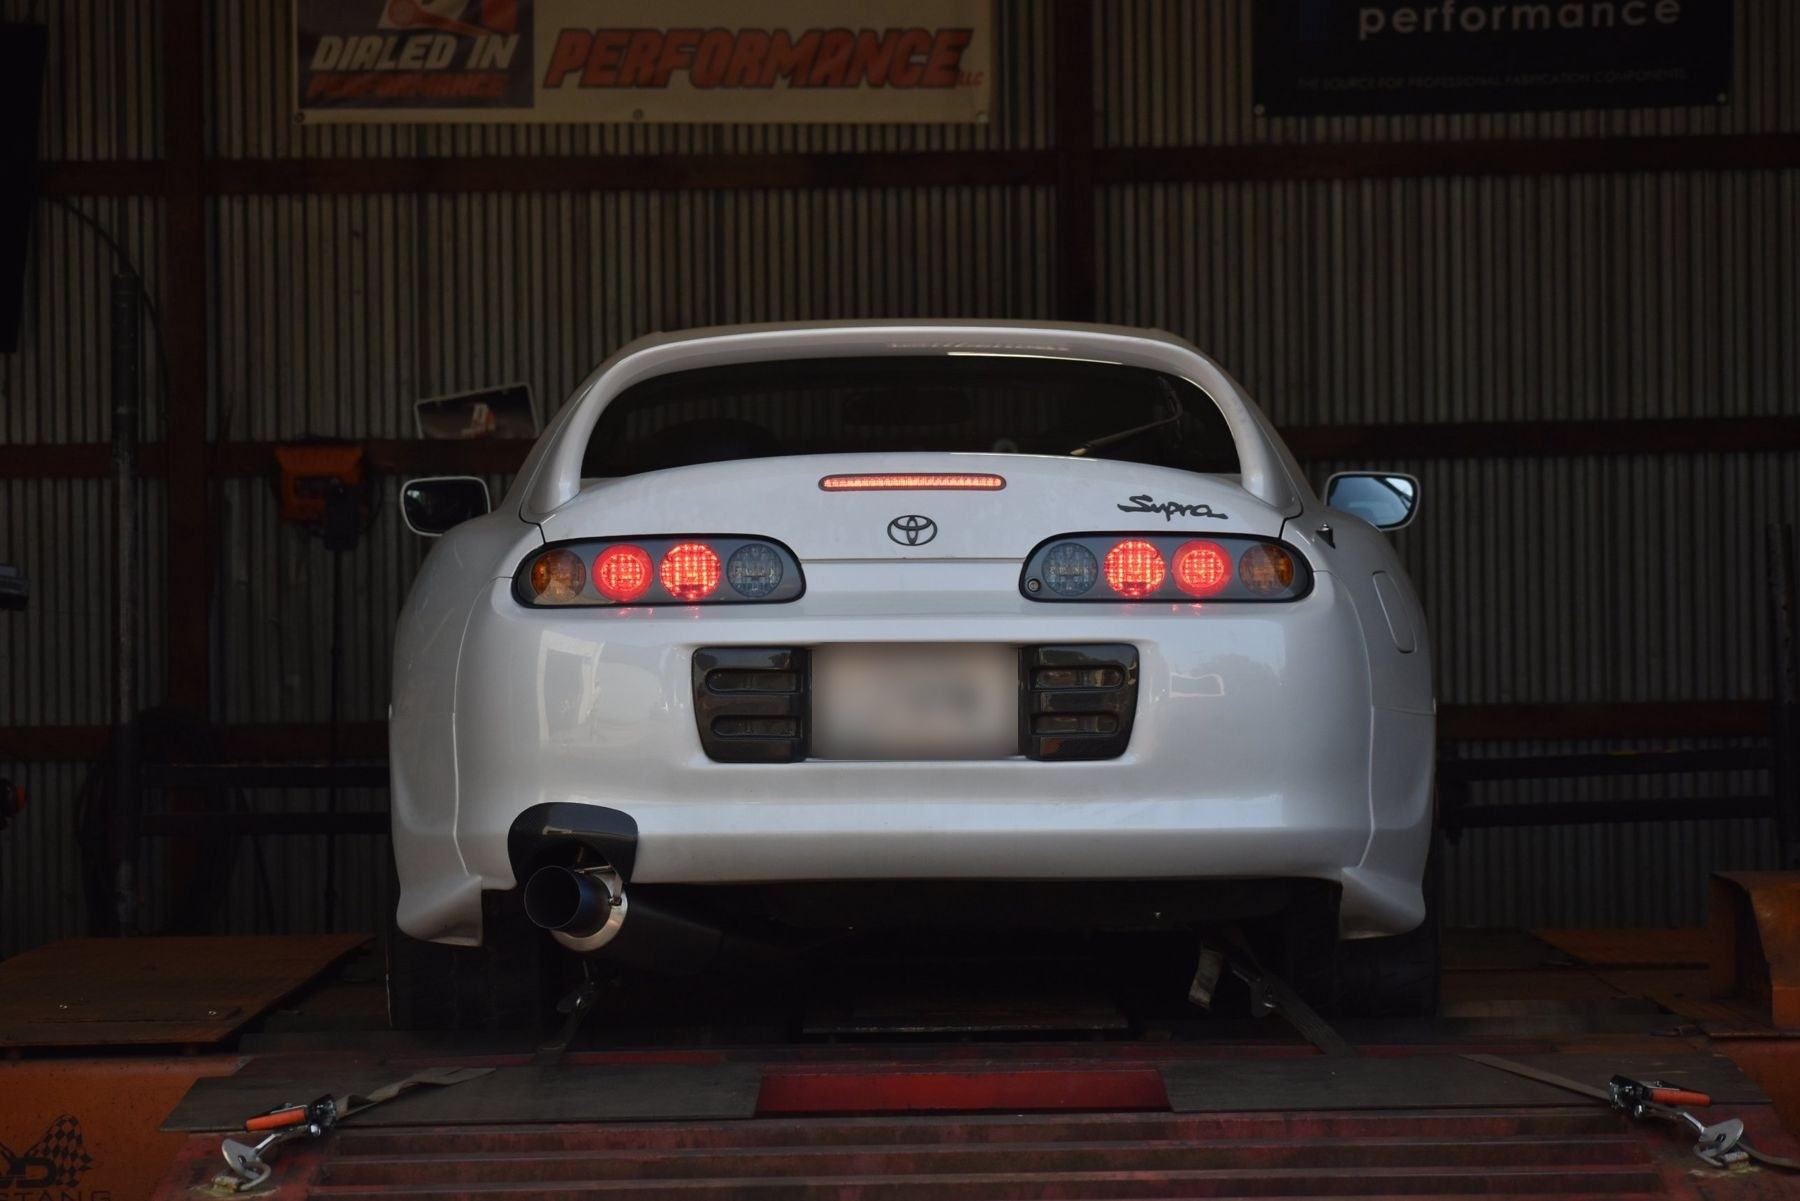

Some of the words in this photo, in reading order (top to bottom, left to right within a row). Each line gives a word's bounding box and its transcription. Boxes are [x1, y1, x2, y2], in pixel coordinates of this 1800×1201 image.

[1358, 0, 1681, 41] performance
[309, 34, 458, 71] DIALED
[465, 33, 520, 70] IN
[542, 27, 974, 88] PERFORMANCE
[1117, 494, 1228, 522] Supra
